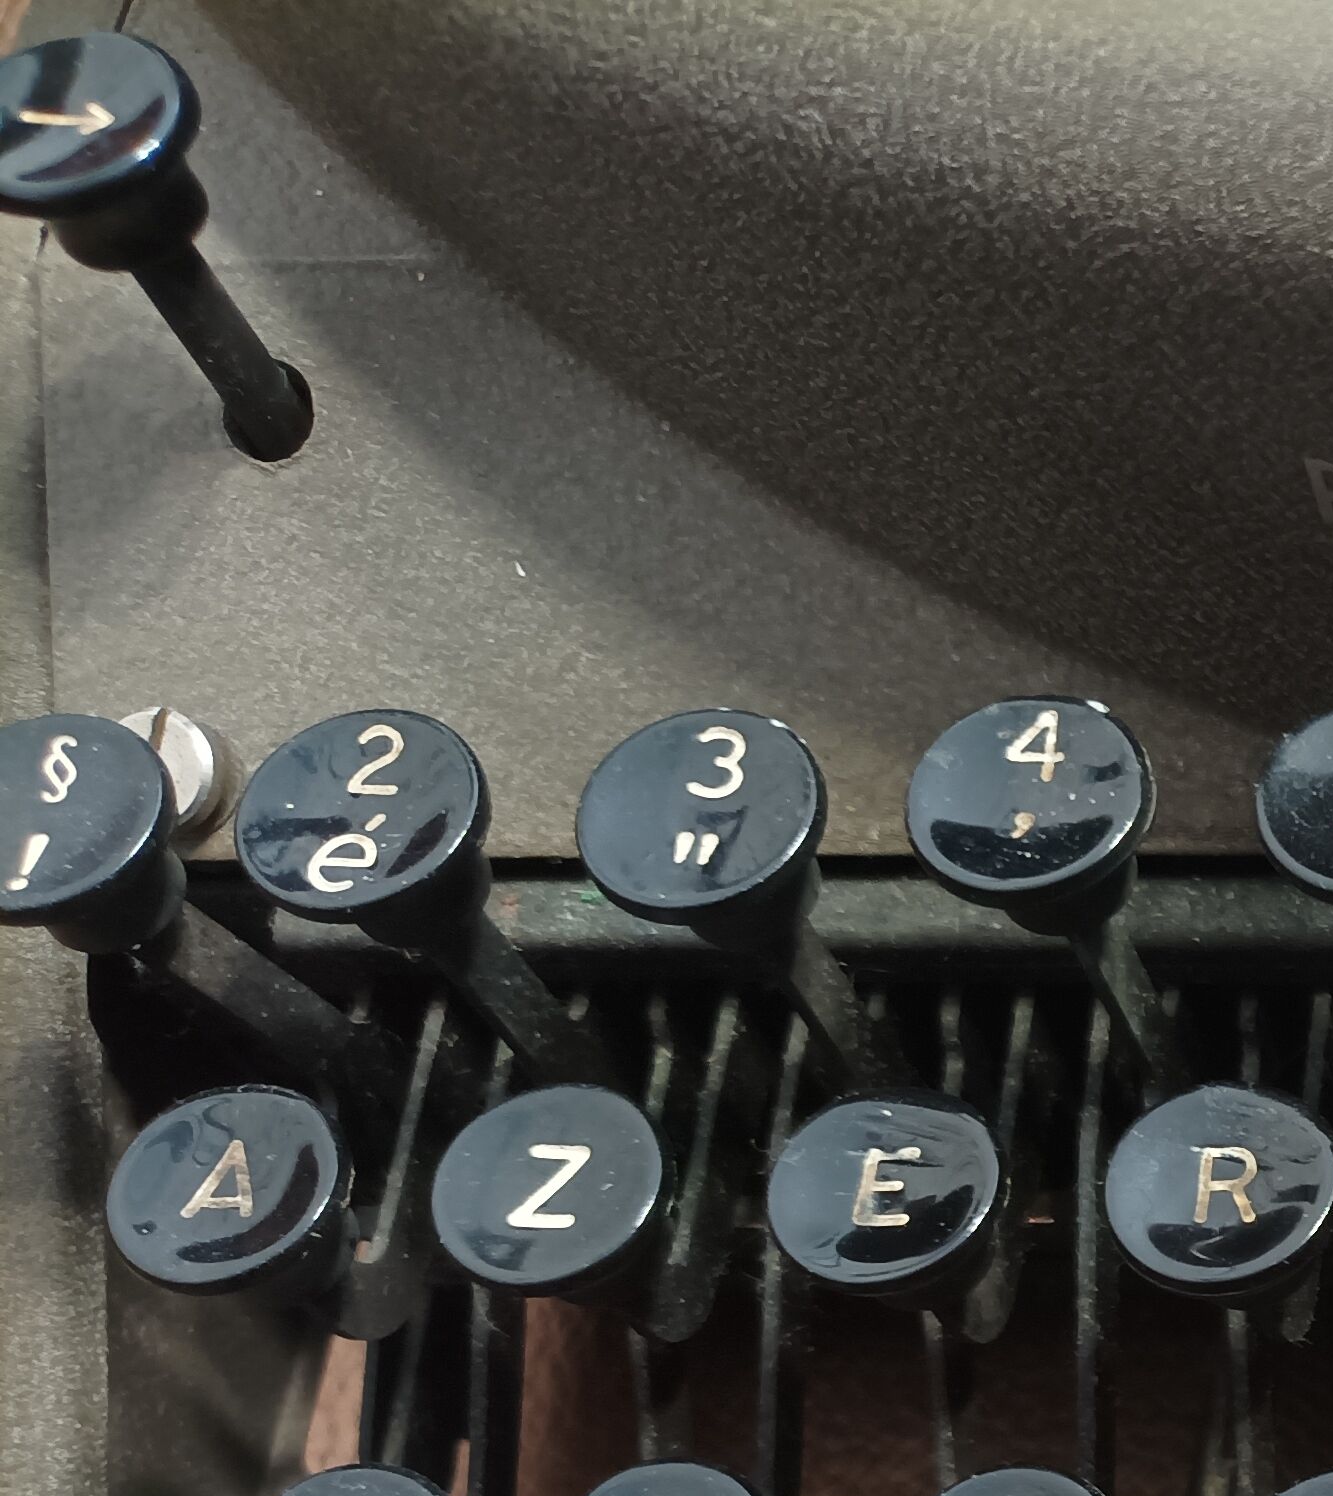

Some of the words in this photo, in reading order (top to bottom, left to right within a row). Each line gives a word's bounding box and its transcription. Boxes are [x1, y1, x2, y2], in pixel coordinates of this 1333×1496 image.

[347, 724, 404, 796] 2
[687, 726, 746, 799] 3
[1004, 709, 1064, 783] 4
[307, 814, 388, 892] é
[180, 1139, 253, 1219] A
[506, 1143, 592, 1230] Z
[851, 1146, 923, 1228] E
[1191, 1145, 1258, 1225] R
